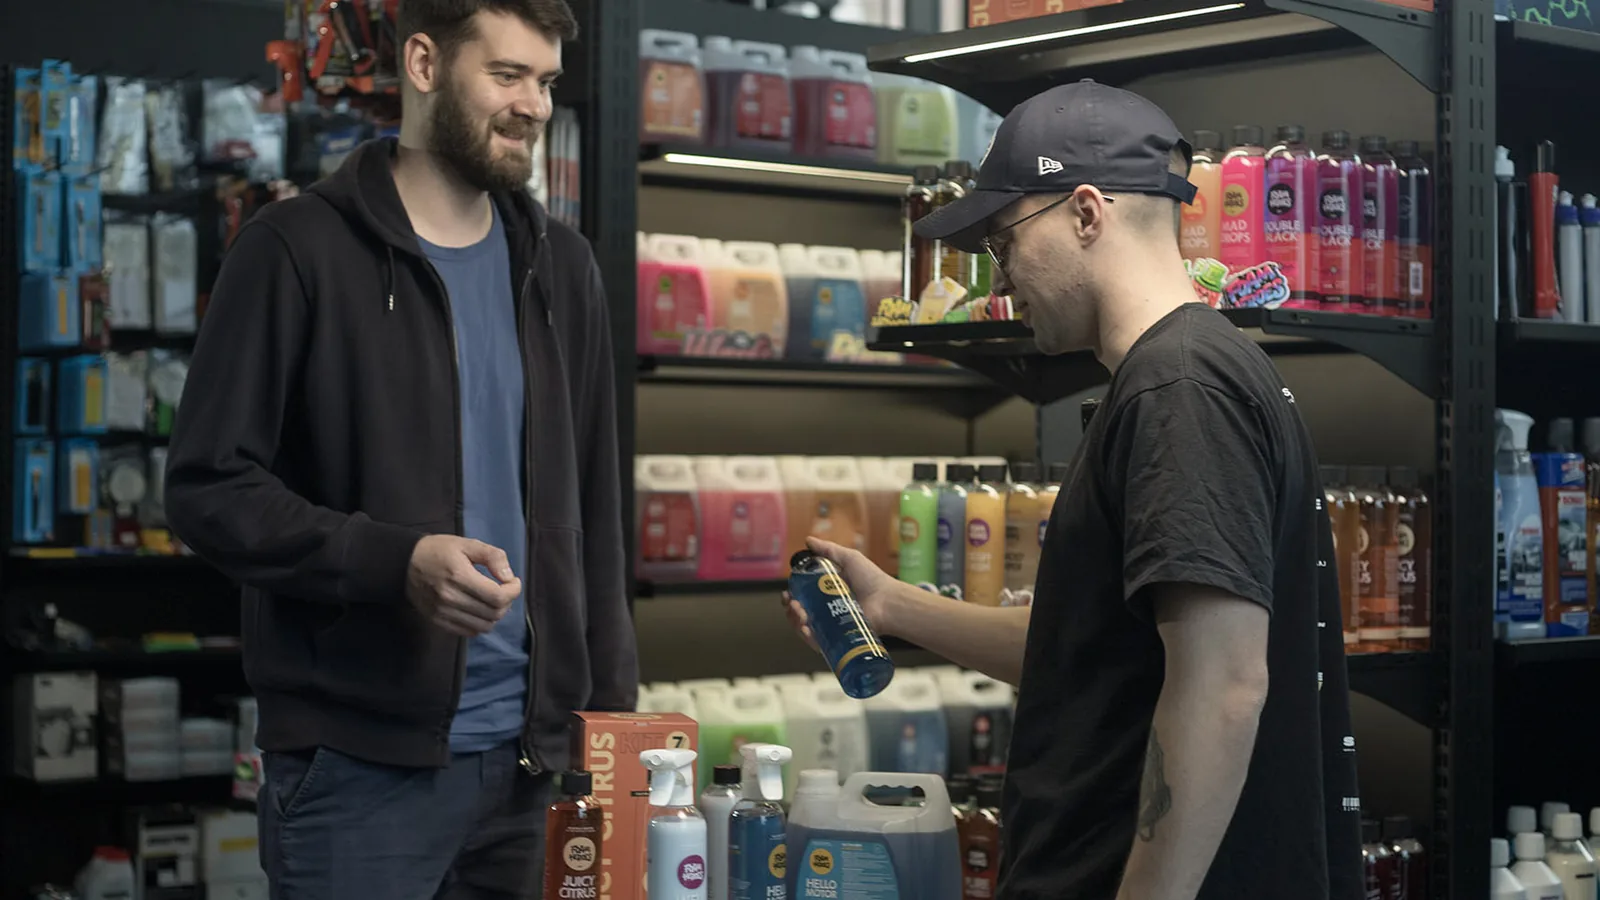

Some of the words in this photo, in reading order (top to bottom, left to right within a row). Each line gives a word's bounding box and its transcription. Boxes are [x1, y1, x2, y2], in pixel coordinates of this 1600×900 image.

[562, 875, 597, 887] JUICY
[805, 878, 838, 890] HELLO
[558, 887, 597, 899] CITRUS
[805, 888, 838, 899] MOTOR
